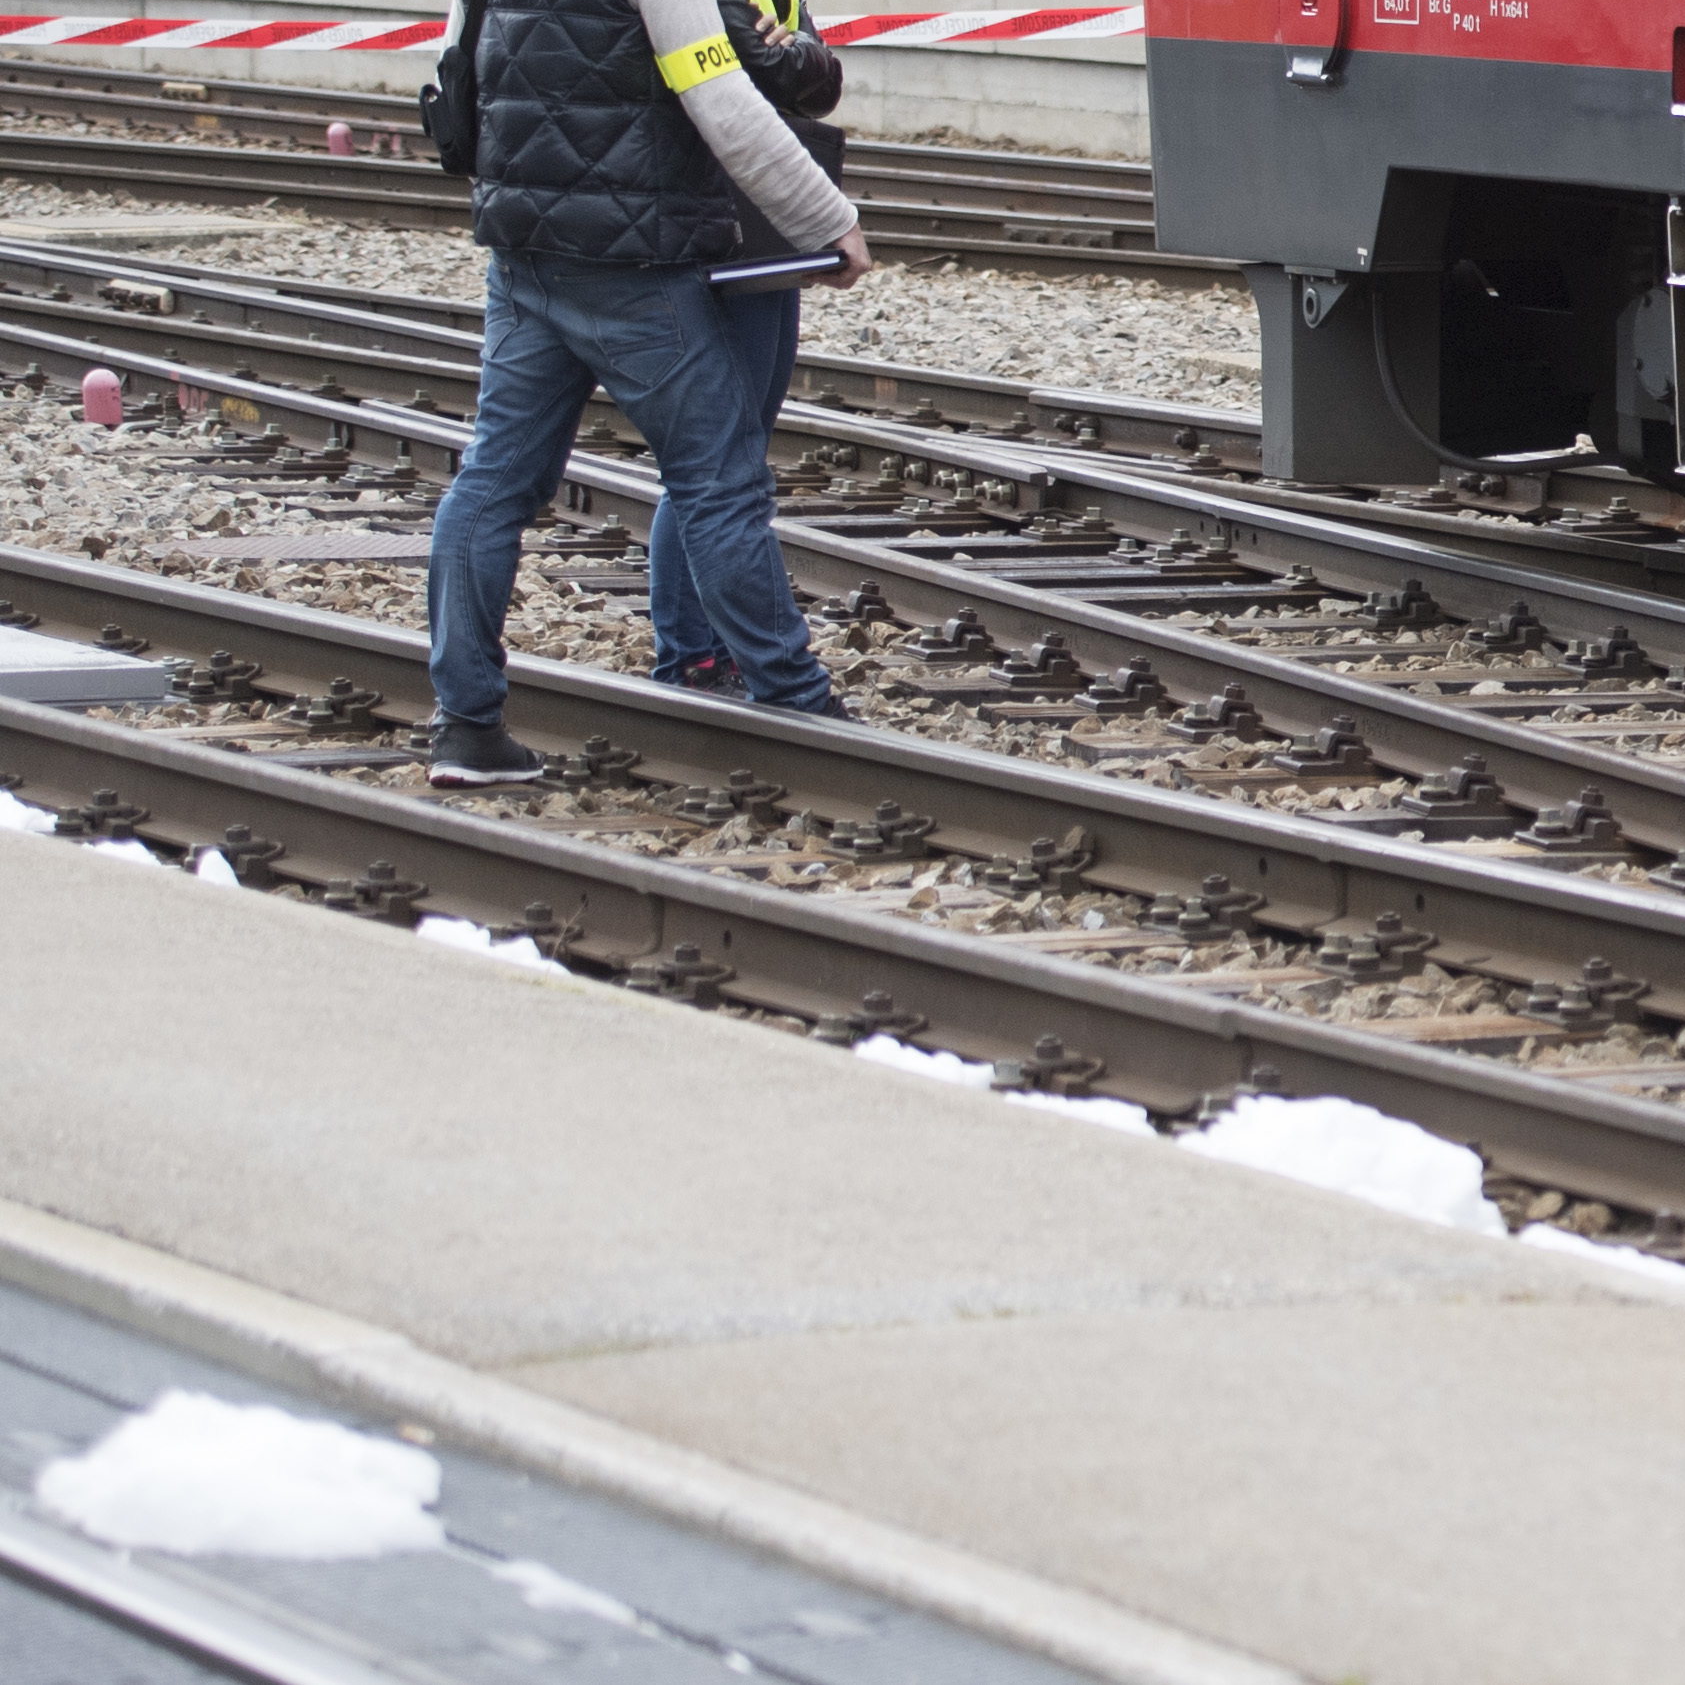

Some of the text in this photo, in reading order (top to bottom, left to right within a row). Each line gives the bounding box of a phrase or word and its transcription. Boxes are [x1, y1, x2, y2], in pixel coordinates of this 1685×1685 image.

[1490, 0, 1529, 19] H 1x64 t
[1453, 13, 1481, 32] P 40 t
